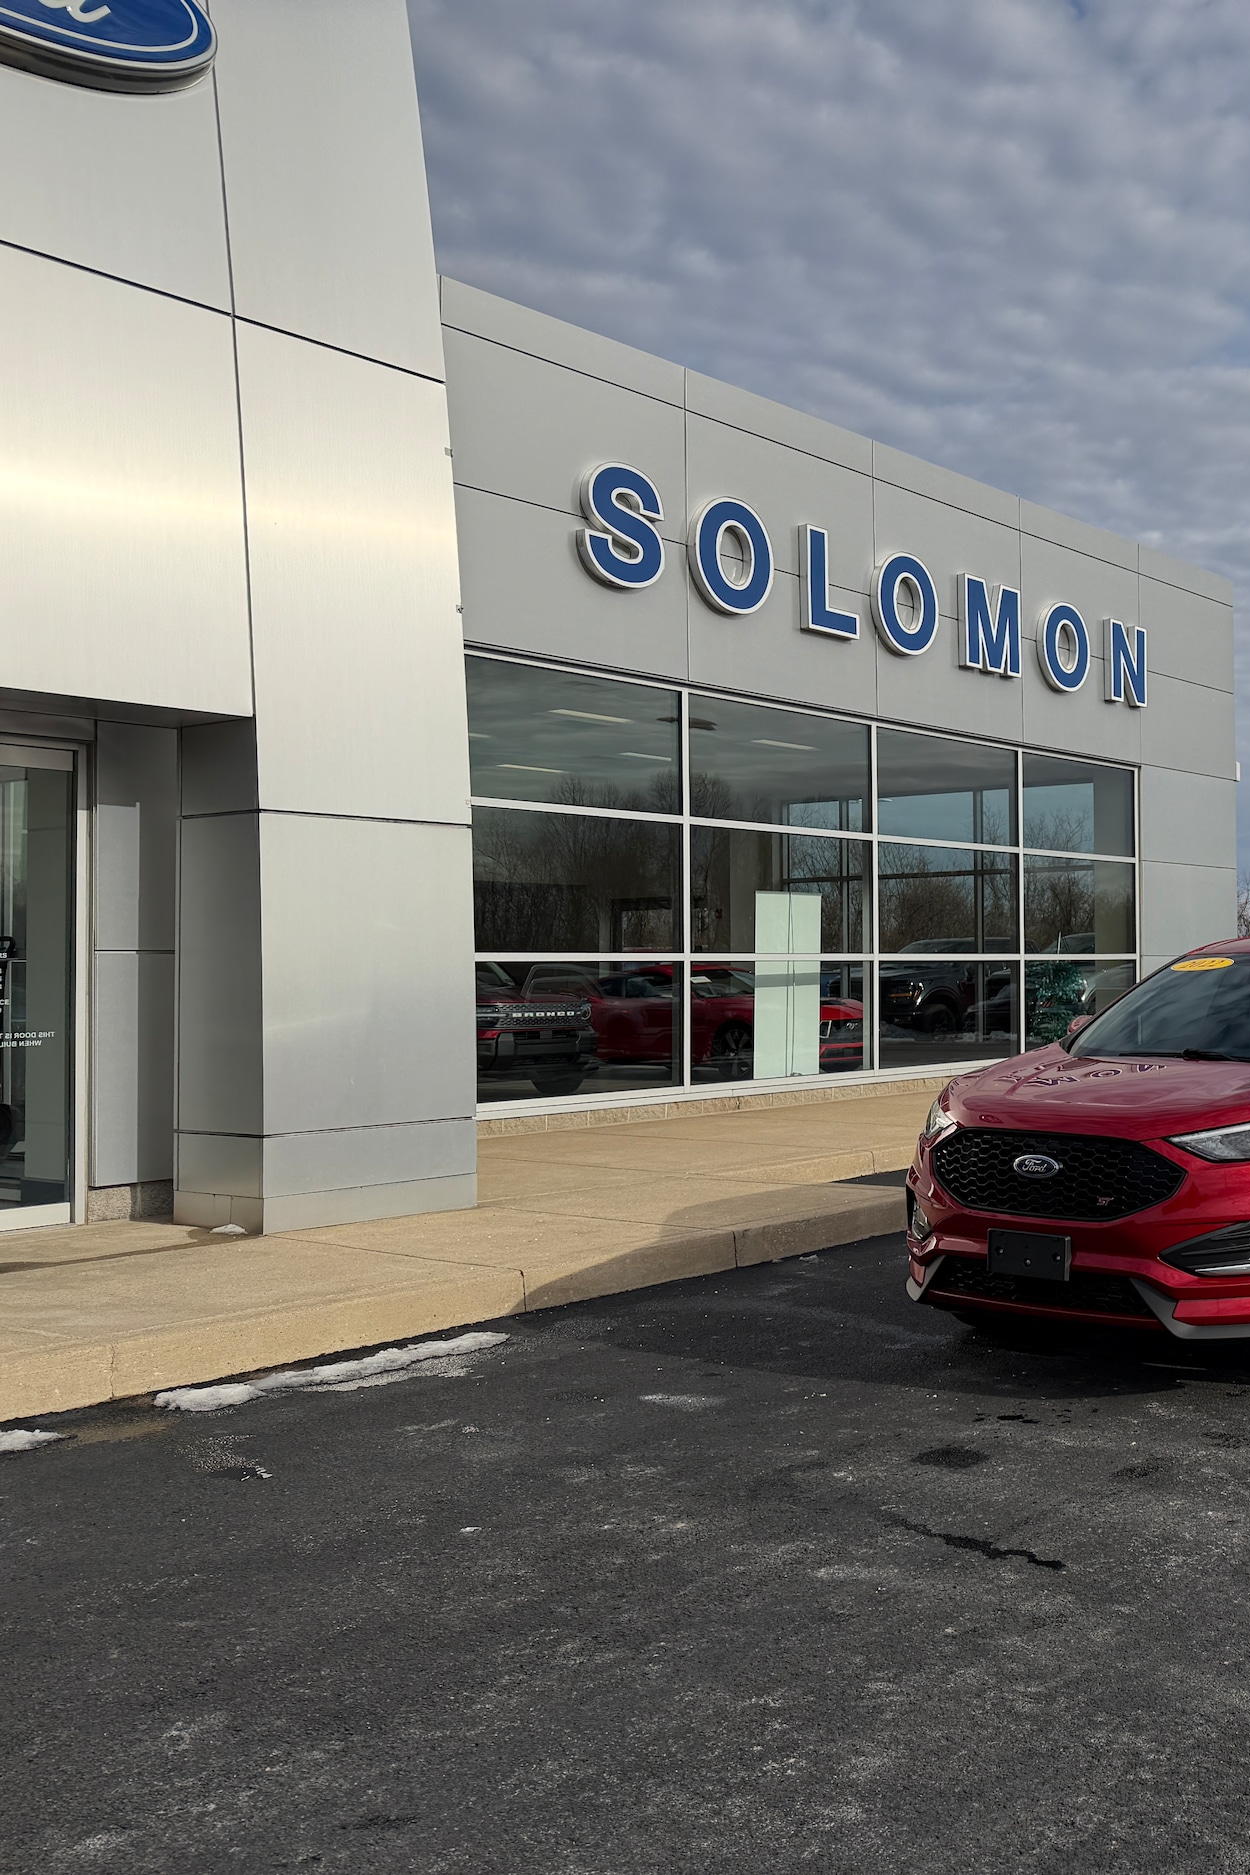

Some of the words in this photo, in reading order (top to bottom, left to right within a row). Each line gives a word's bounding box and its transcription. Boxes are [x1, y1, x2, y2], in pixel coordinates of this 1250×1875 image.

[576, 461, 1148, 708] SOLOMON
[1022, 1159, 1048, 1173] Ford
[1096, 1197, 1115, 1206] ST
